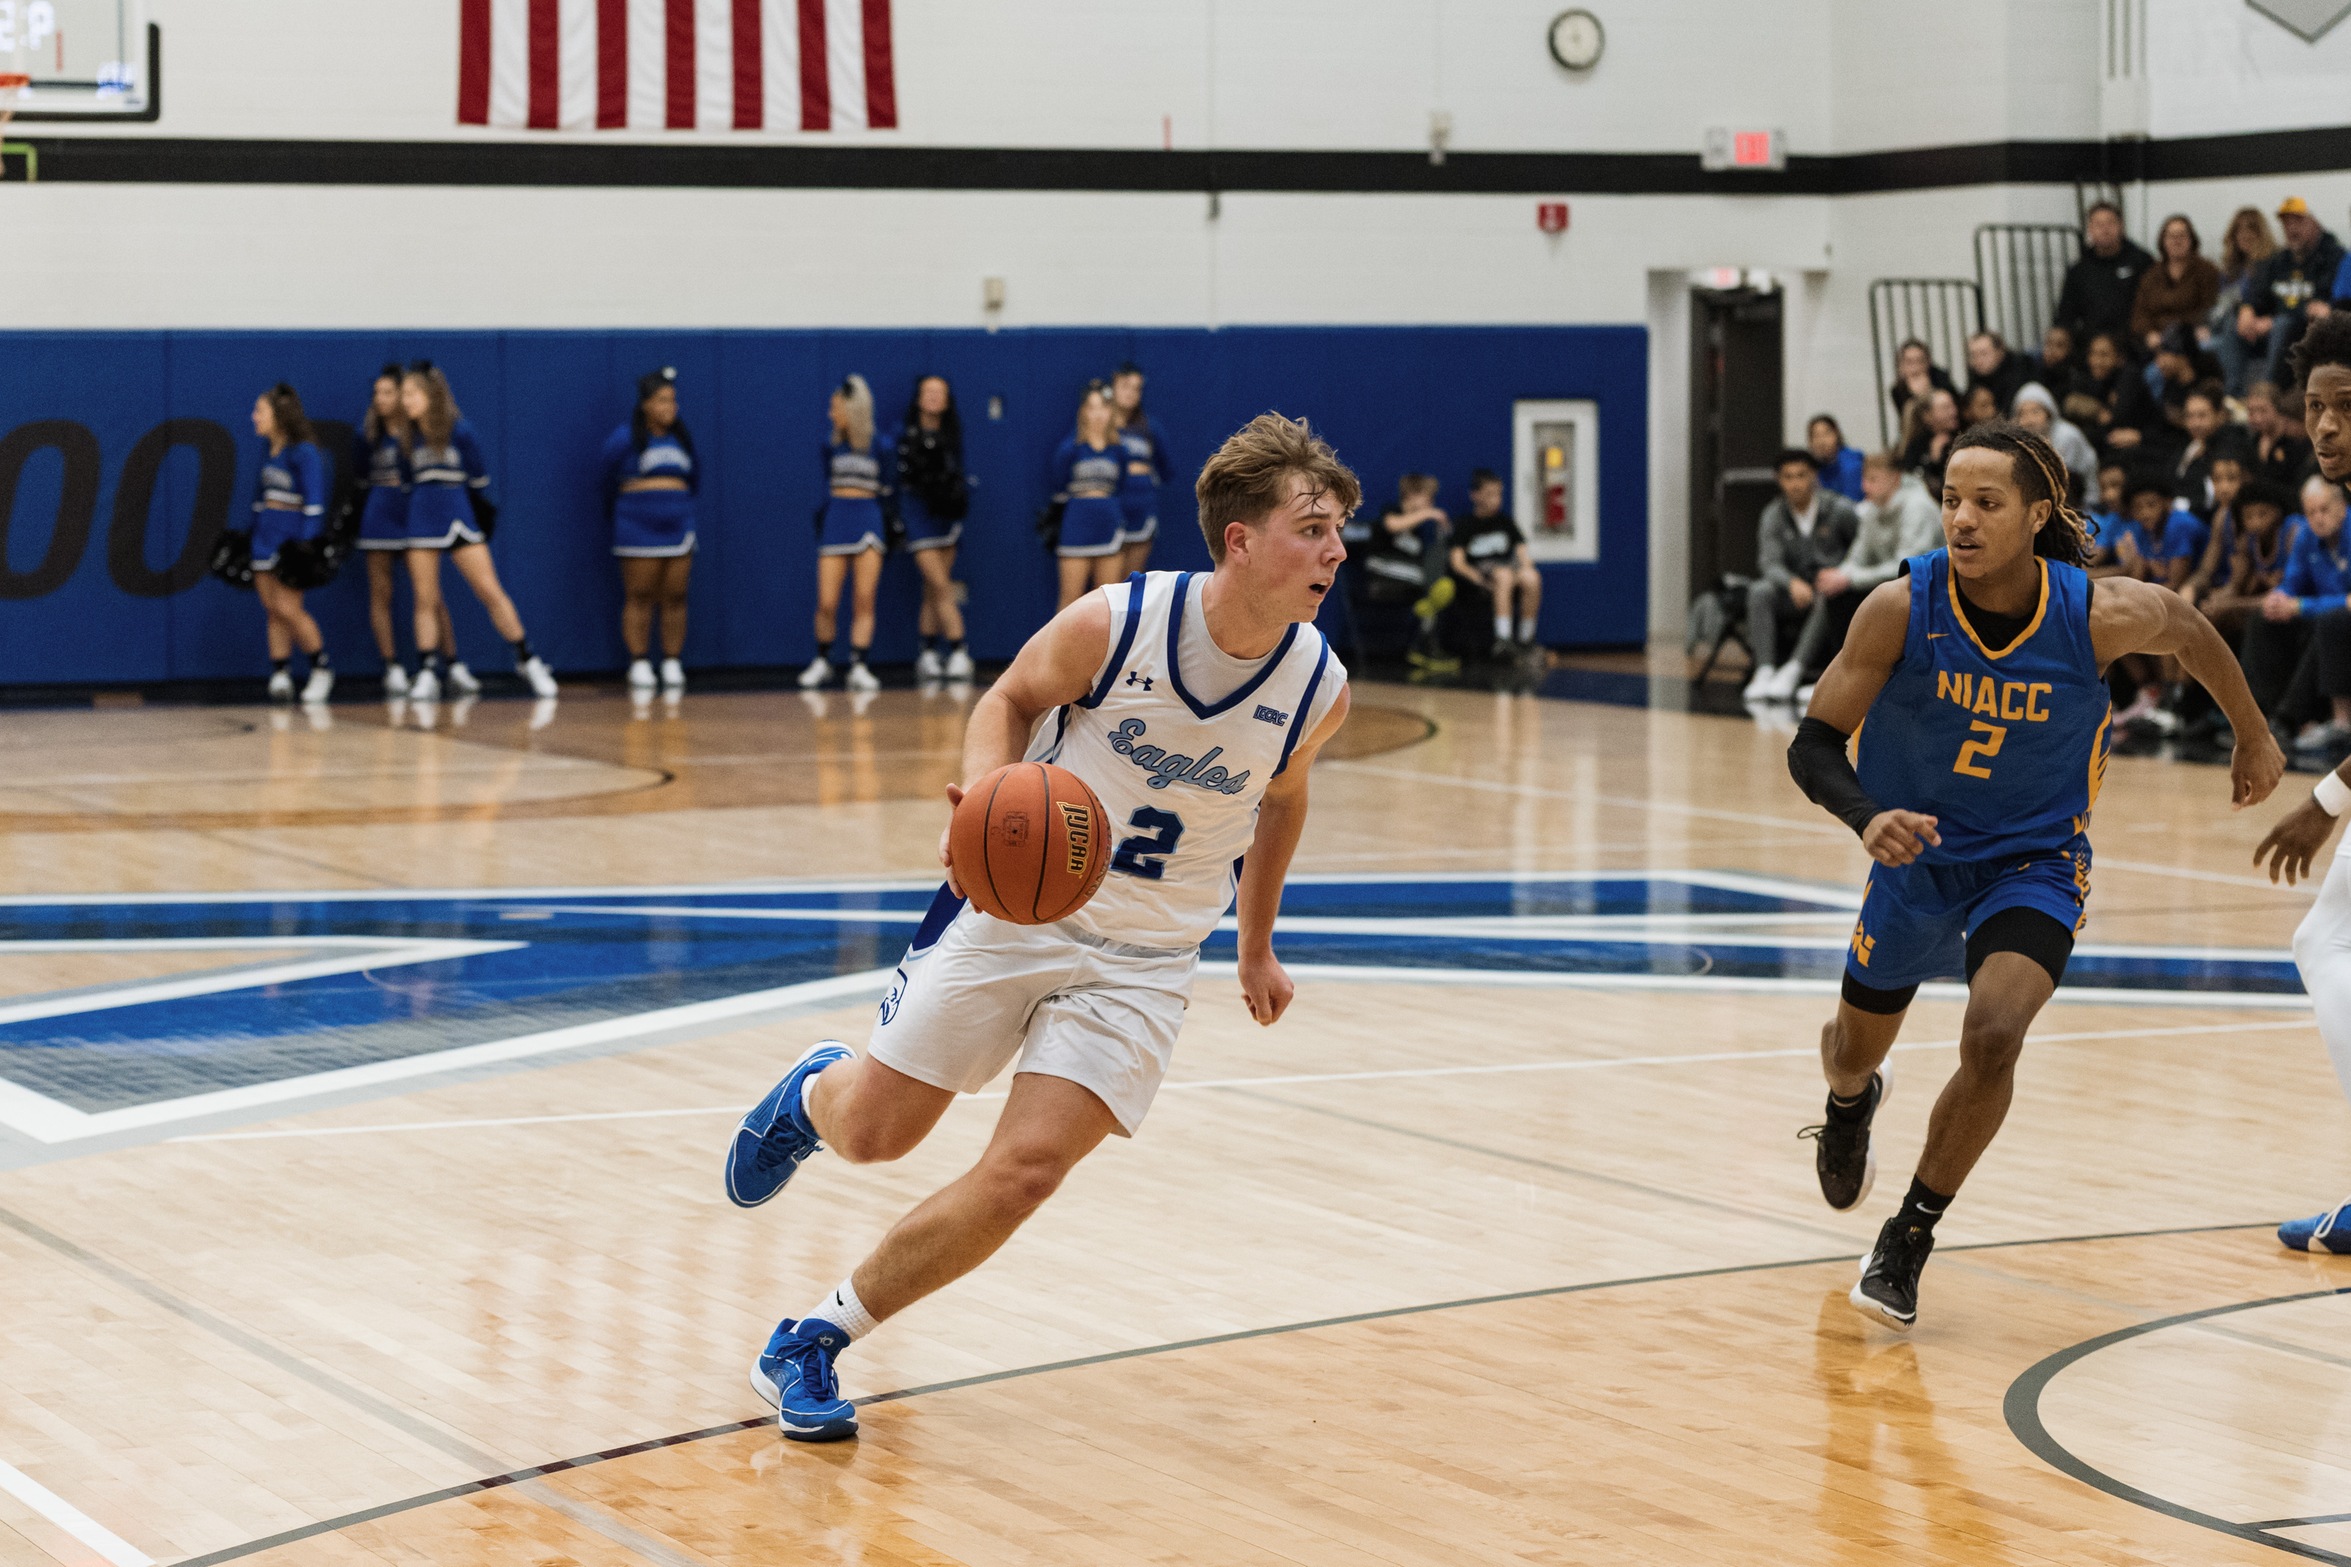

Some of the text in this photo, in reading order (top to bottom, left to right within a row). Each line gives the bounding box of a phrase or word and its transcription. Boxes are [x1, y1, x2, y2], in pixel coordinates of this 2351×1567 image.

[1937, 670, 2052, 722] NIACC
[1107, 718, 1251, 795] Eagles
[1953, 719, 2008, 779] 2
[1058, 802, 1090, 874] NJCAA
[1110, 804, 1186, 880] 2
